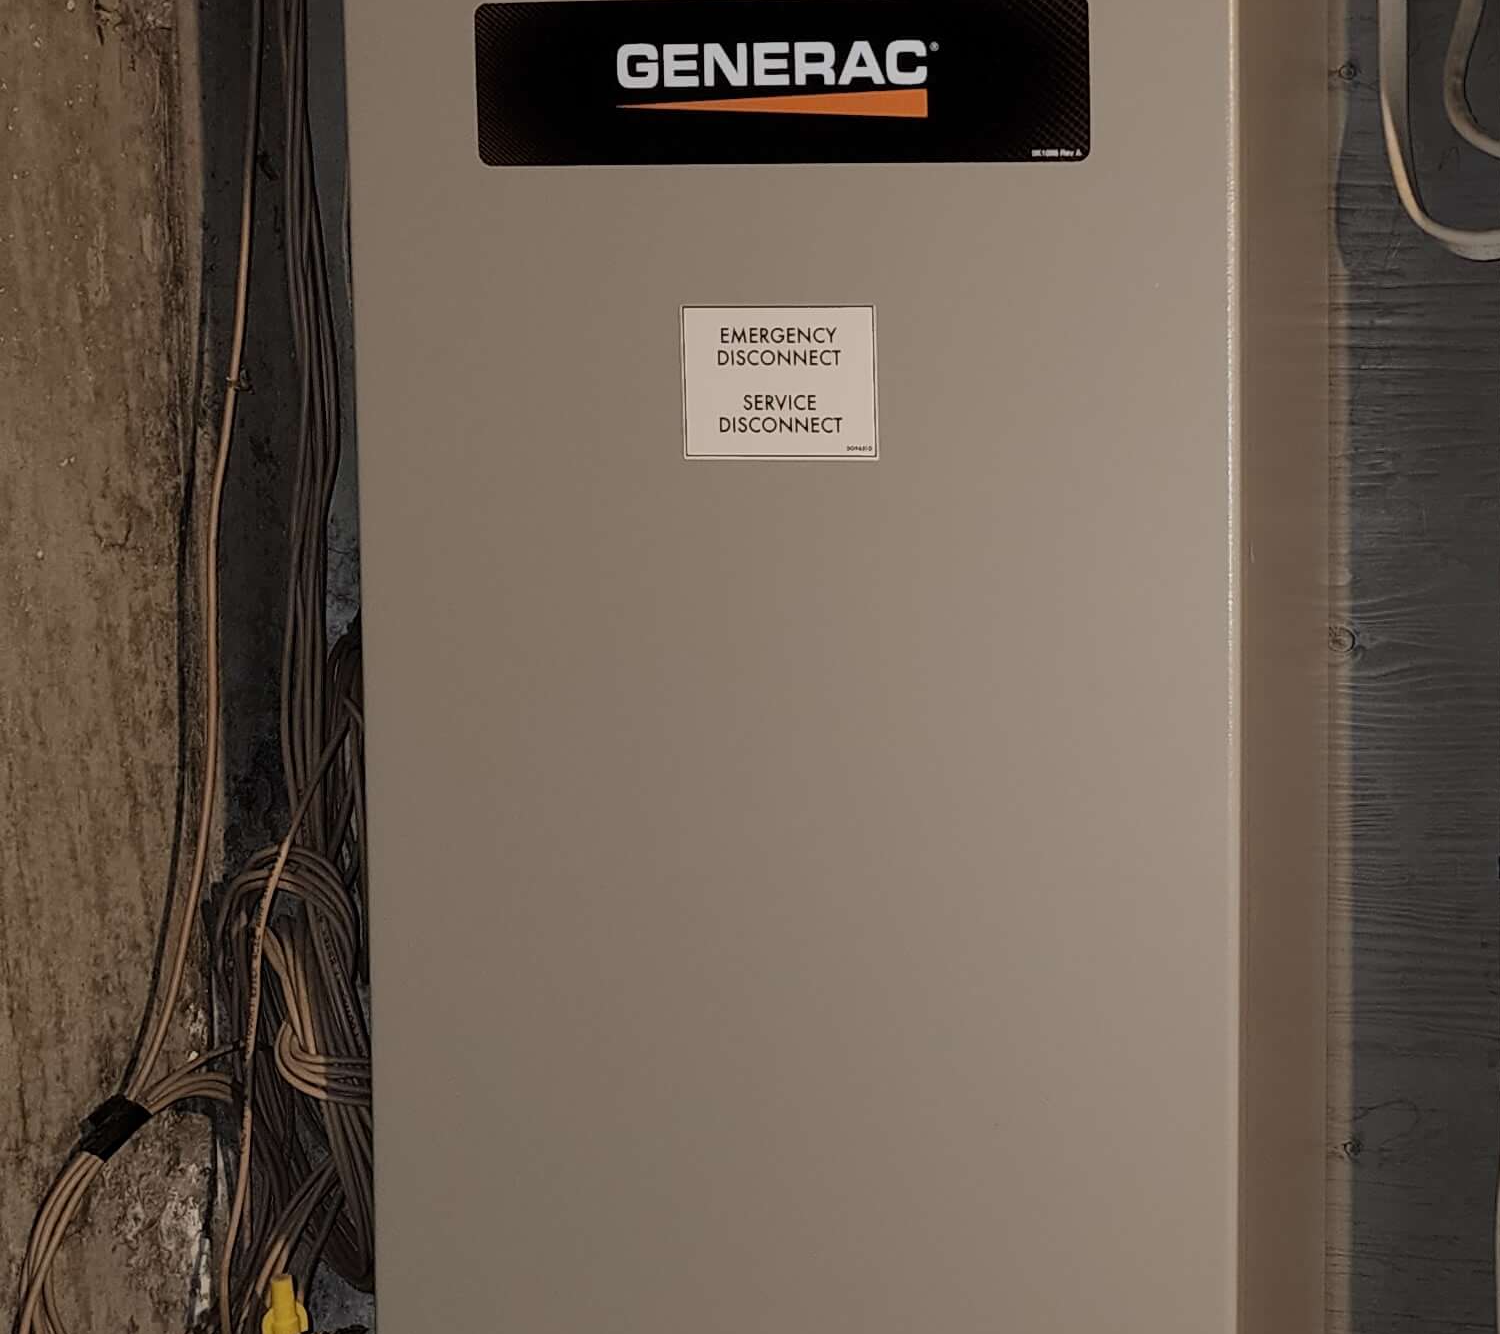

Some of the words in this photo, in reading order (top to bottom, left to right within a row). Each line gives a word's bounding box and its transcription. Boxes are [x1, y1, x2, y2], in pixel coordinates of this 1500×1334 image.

[616, 39, 929, 89] GENERAC
[720, 327, 838, 344] EMERGENCY
[717, 349, 841, 366] DISCONNECT
[743, 394, 817, 411] SERVICE
[719, 416, 843, 433] DISCONNECT
